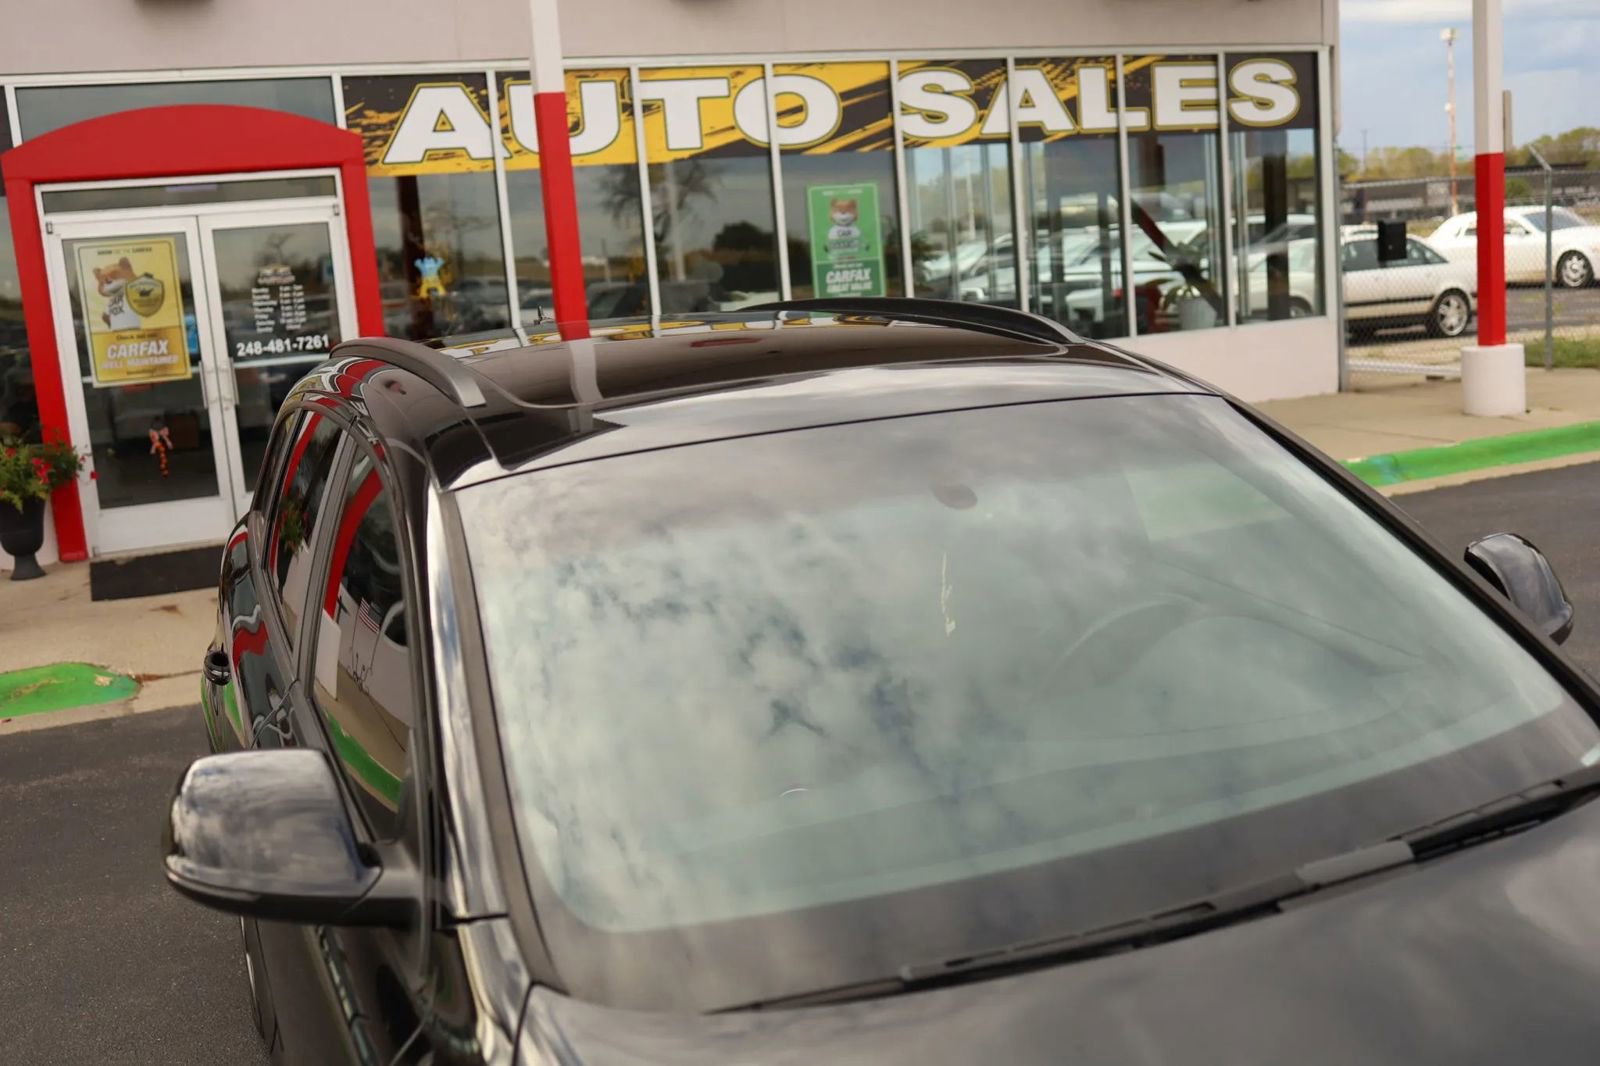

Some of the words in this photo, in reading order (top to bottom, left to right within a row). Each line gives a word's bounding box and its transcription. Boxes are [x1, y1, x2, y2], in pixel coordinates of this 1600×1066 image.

[382, 74, 842, 164] AUTO
[897, 59, 1299, 139] SALES
[826, 268, 871, 284] CARFAX
[107, 338, 169, 359] CARFAX
[236, 334, 329, 357] 248-481-7261
